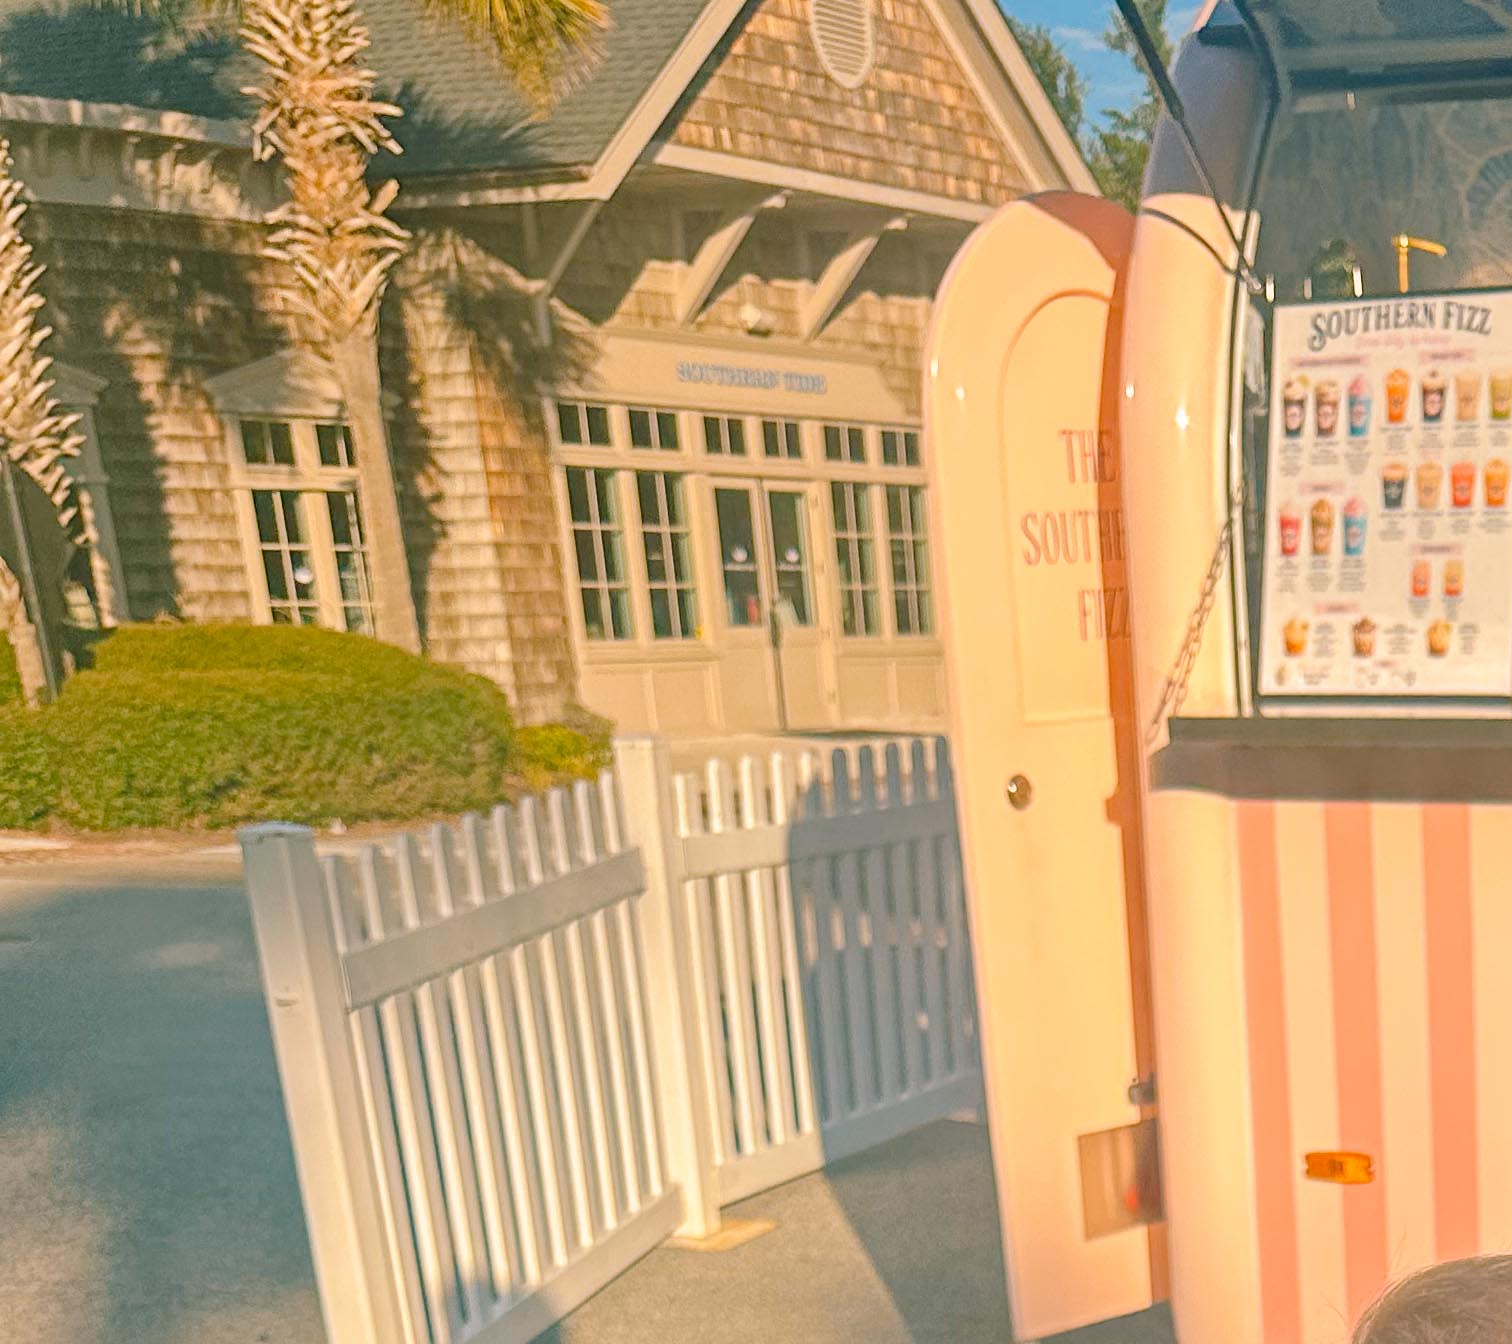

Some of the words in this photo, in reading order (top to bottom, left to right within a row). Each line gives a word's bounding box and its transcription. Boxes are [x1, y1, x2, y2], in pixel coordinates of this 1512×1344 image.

[1308, 302, 1437, 352] SOUTHERN
[1442, 300, 1492, 336] FIZZ
[1058, 428, 1117, 484] THE
